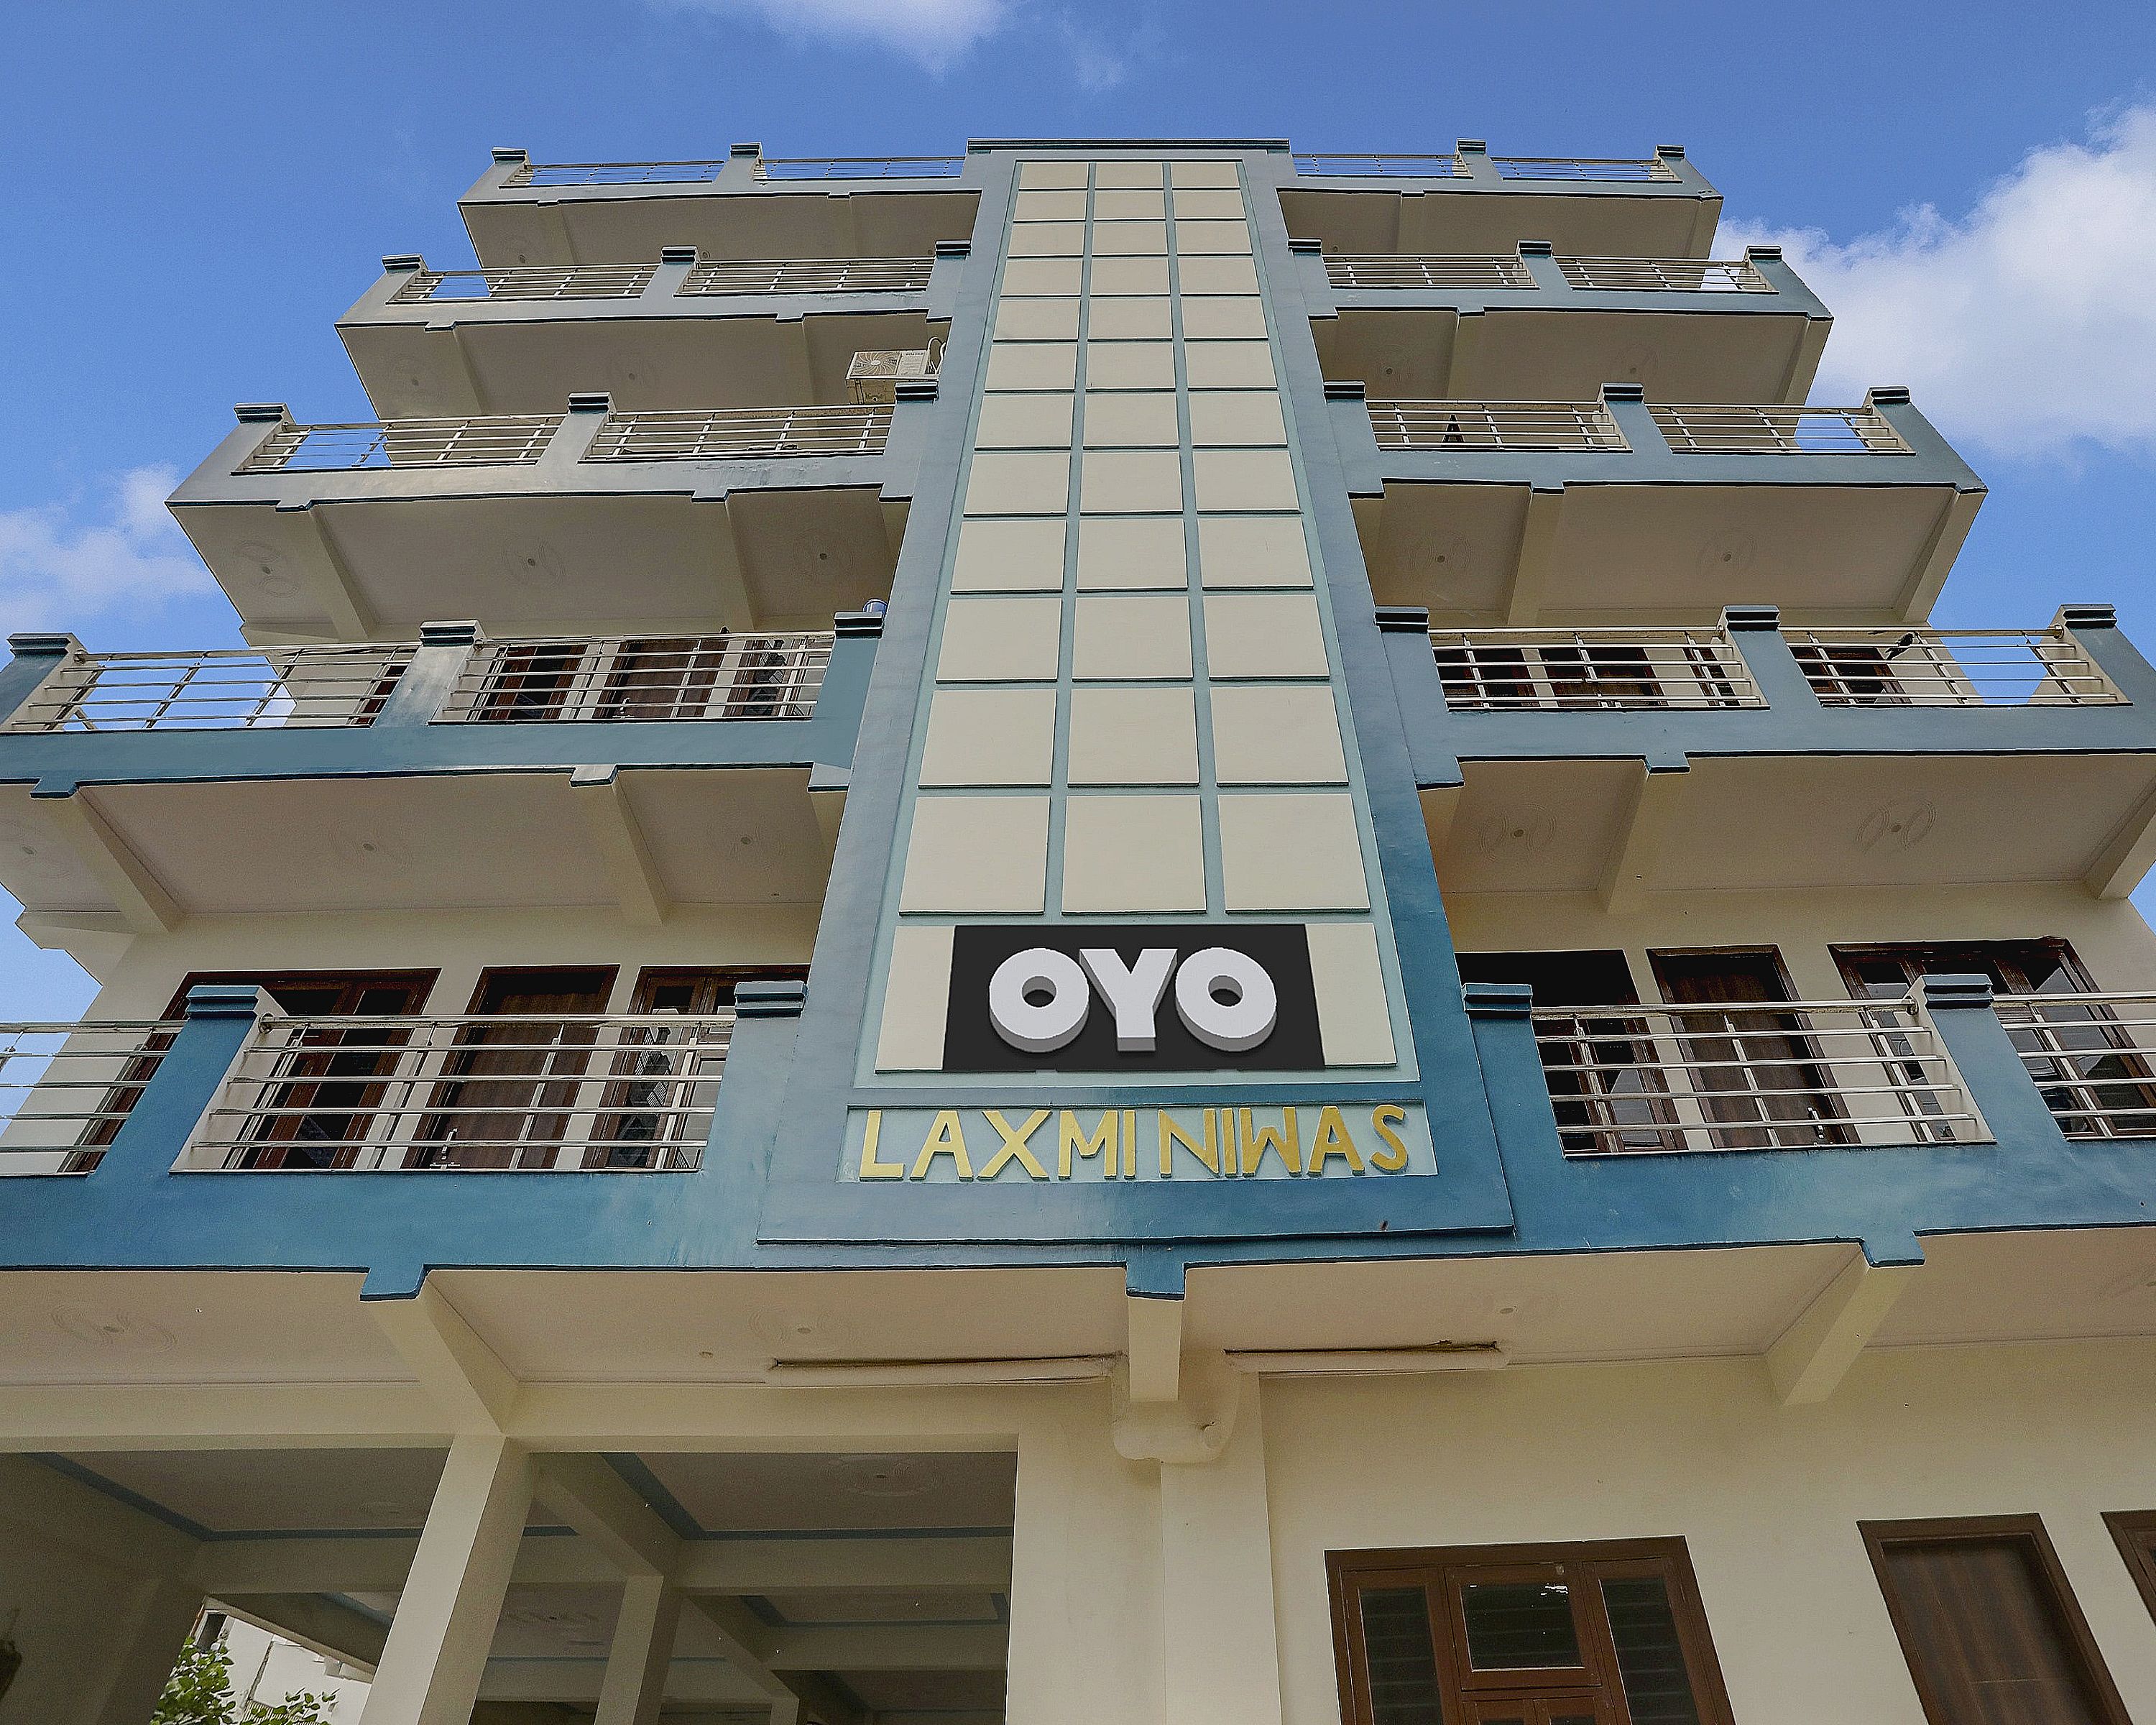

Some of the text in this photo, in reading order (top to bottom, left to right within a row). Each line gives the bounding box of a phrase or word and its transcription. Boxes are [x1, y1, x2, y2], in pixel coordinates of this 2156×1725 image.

[990, 947, 1277, 1052] OYO
[859, 1105, 1409, 1181] LAXMI NIWAS
